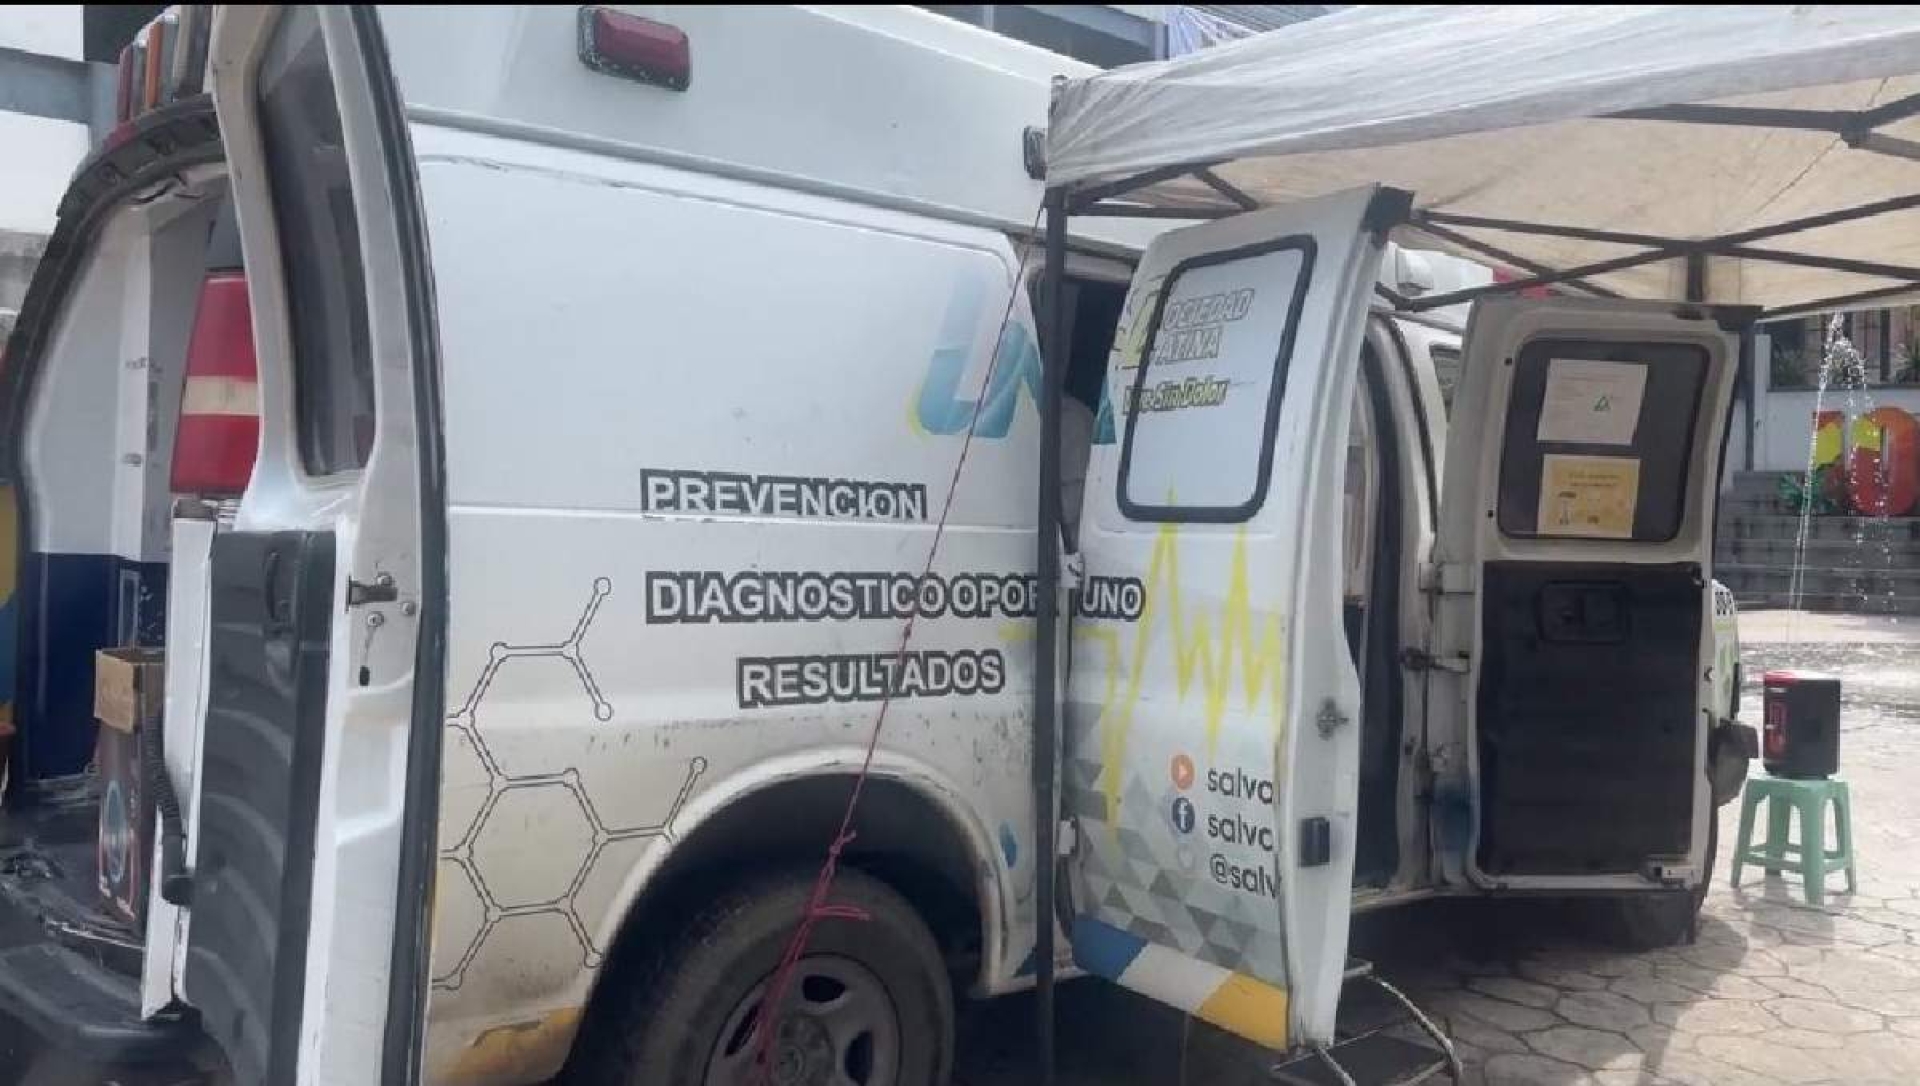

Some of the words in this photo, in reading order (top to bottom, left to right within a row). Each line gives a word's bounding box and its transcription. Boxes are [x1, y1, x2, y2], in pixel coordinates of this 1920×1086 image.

[641, 468, 927, 519] PREVENCION
[646, 571, 944, 623] DIAGNOSTICO
[948, 573, 1145, 622] OPOUNO
[737, 650, 1004, 708] RESULTADOS
